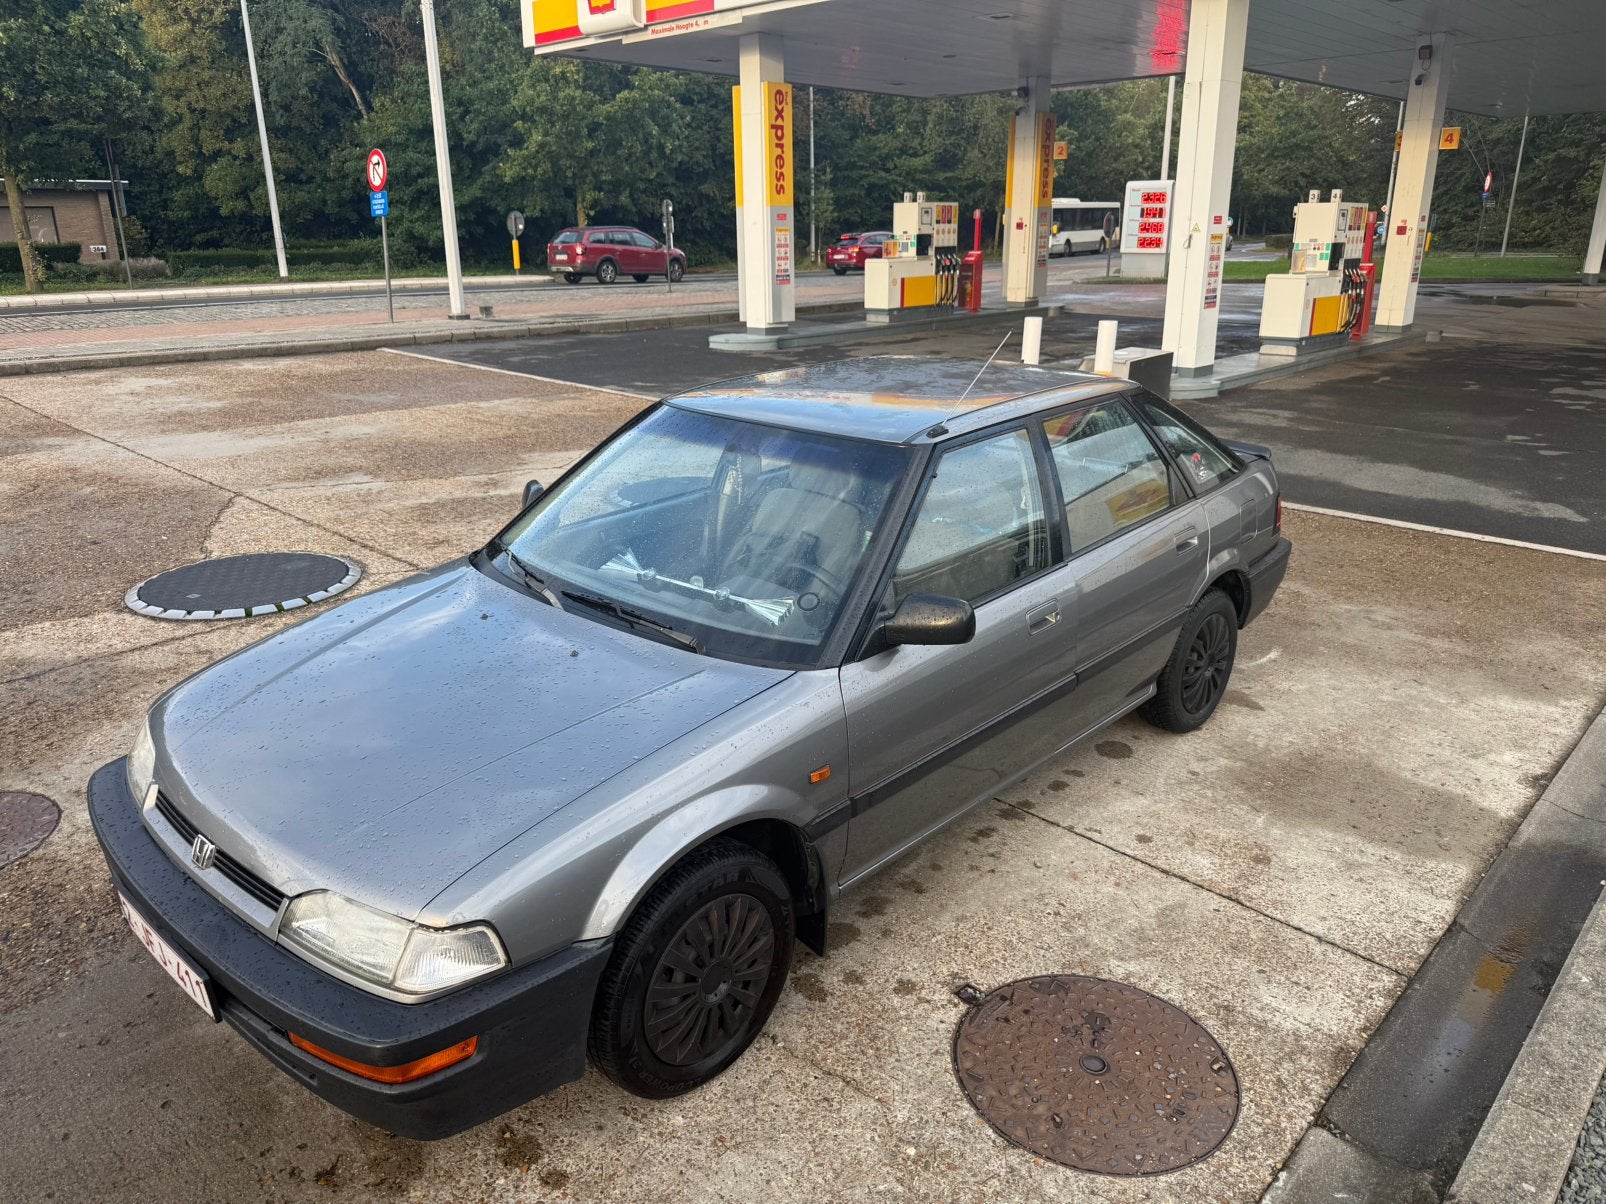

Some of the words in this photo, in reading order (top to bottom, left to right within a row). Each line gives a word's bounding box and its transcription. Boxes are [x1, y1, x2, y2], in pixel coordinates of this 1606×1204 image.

[676, 22, 693, 30] Hoogte
[771, 89, 785, 195] express
[1444, 132, 1454, 143] 4
[1057, 146, 1064, 156] 2
[1042, 118, 1051, 198] express
